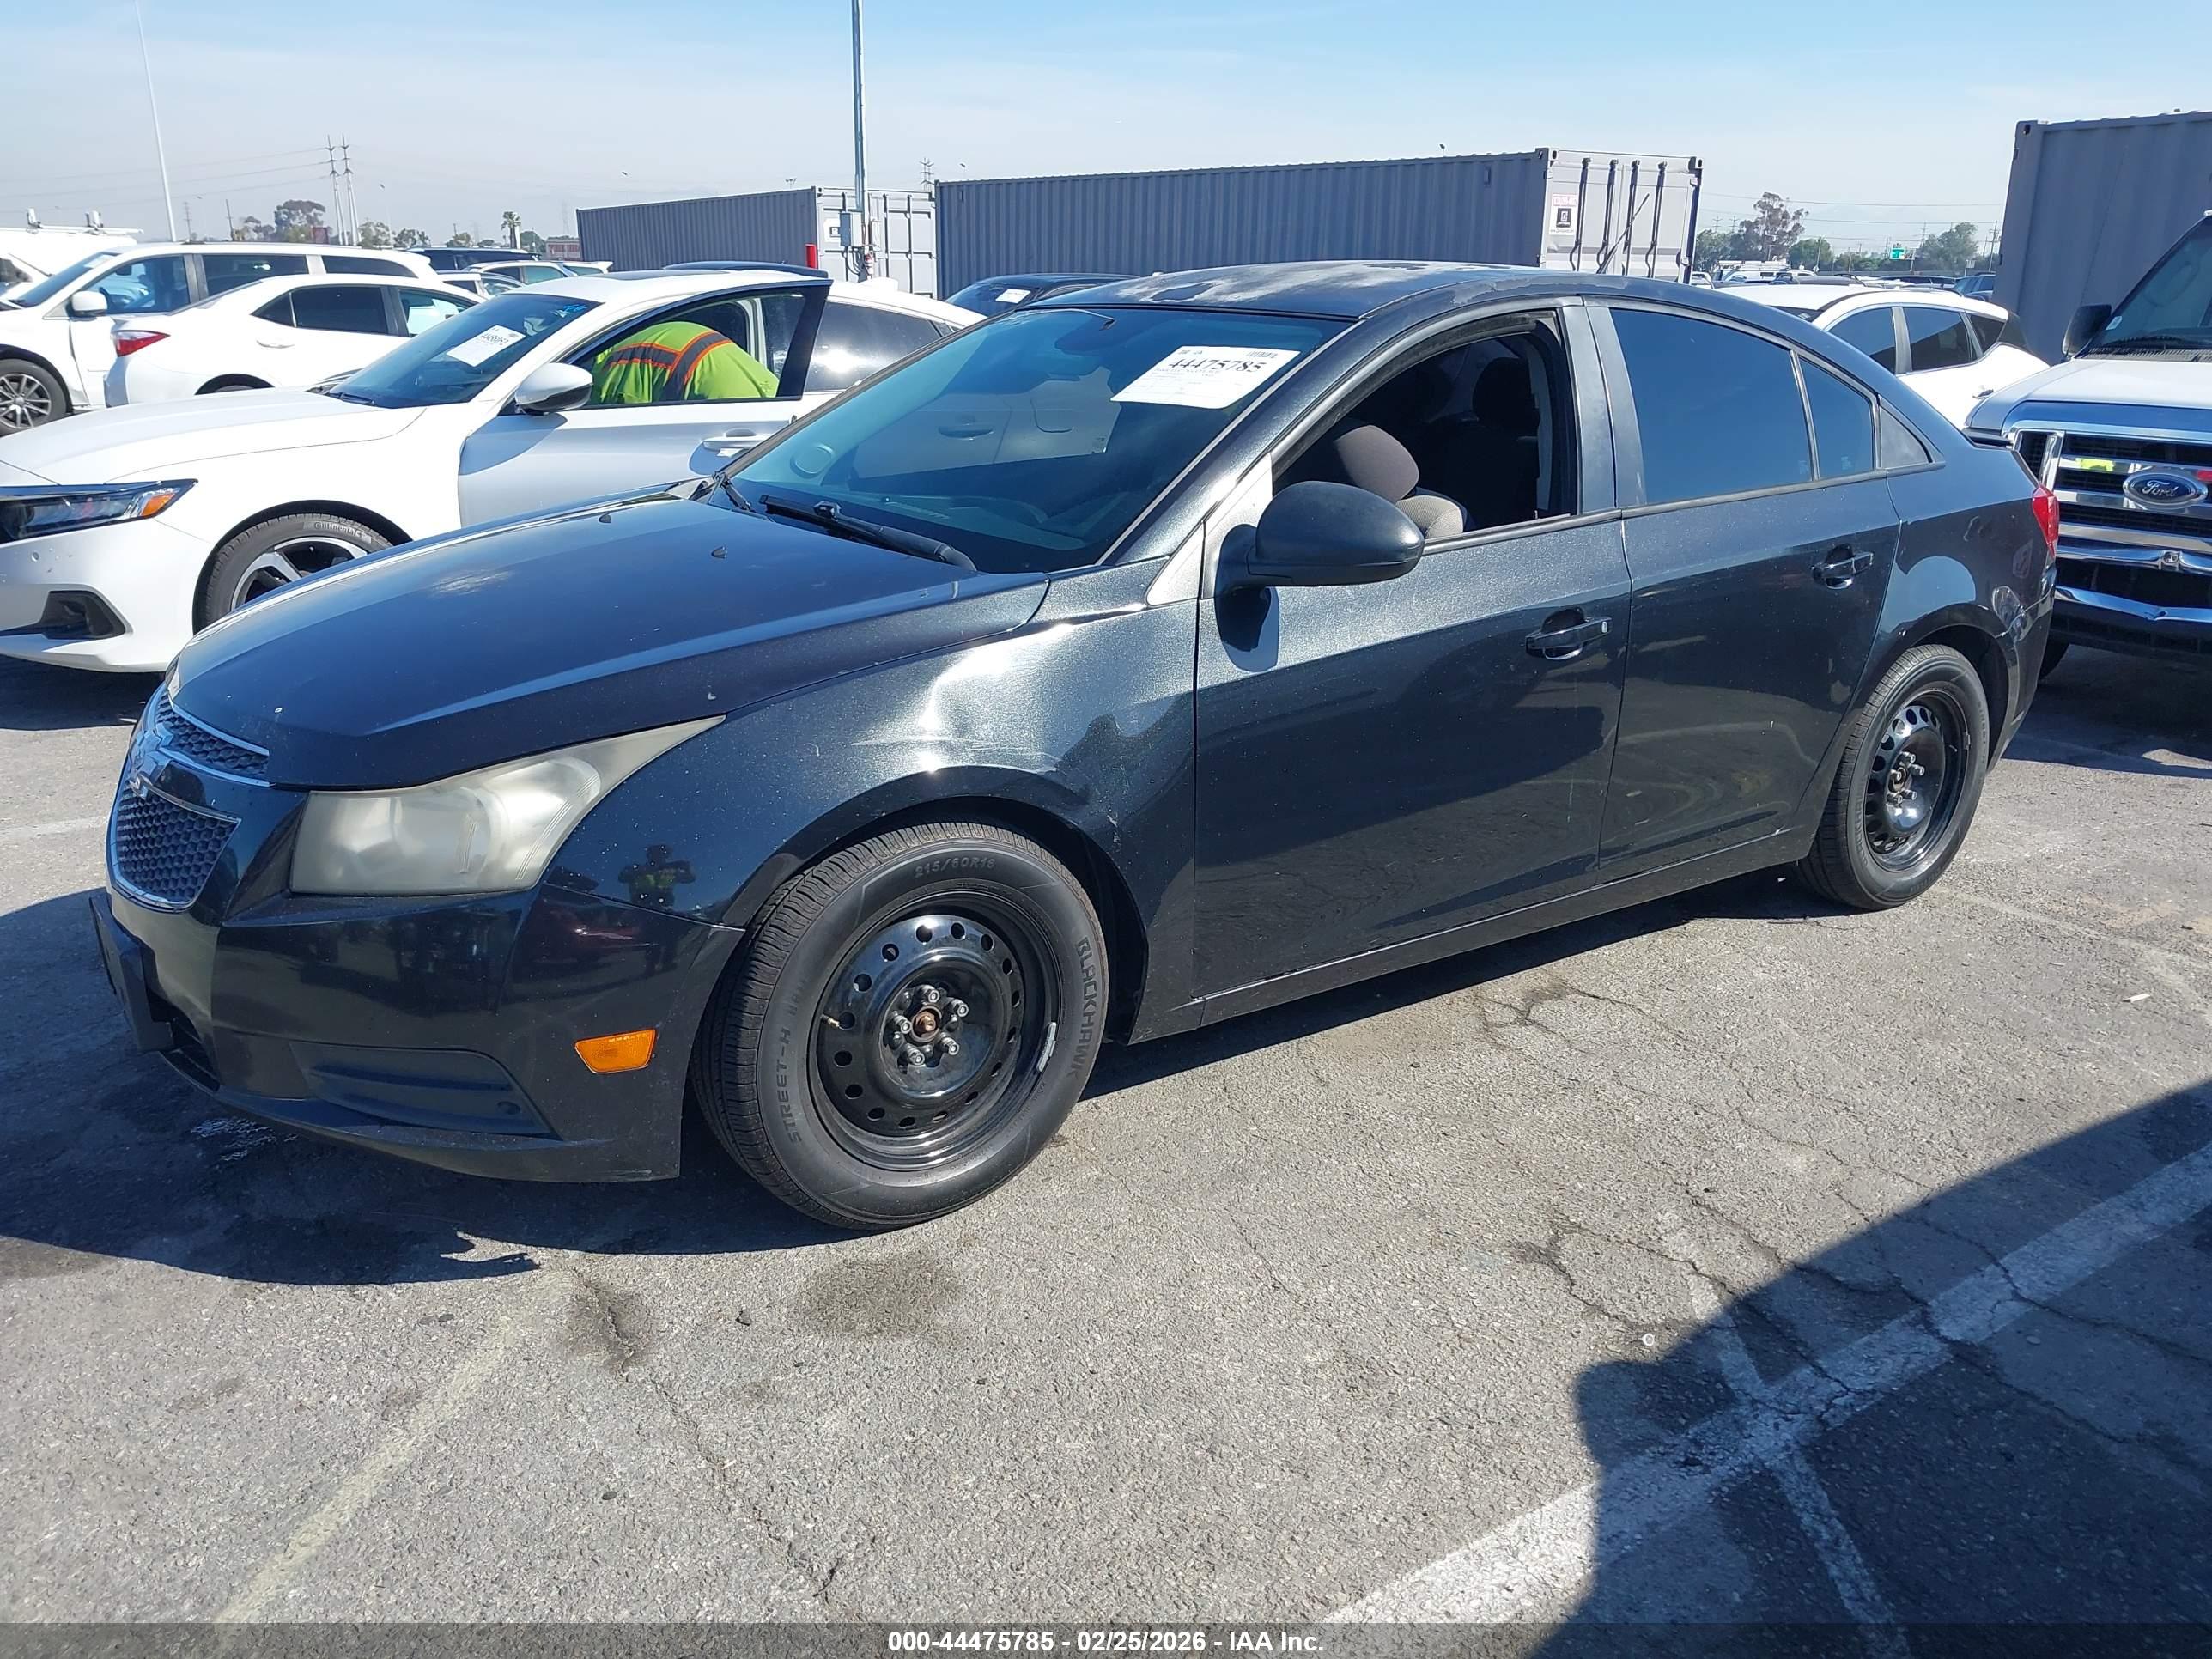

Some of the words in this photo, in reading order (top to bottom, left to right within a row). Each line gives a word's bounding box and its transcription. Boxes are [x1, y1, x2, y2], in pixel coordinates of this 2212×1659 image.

[1169, 358, 1267, 373] 44475785
[2142, 480, 2179, 496] Ford
[1067, 937, 1097, 1080] BLACKHAWK
[776, 1027, 802, 1144] STREET-H
